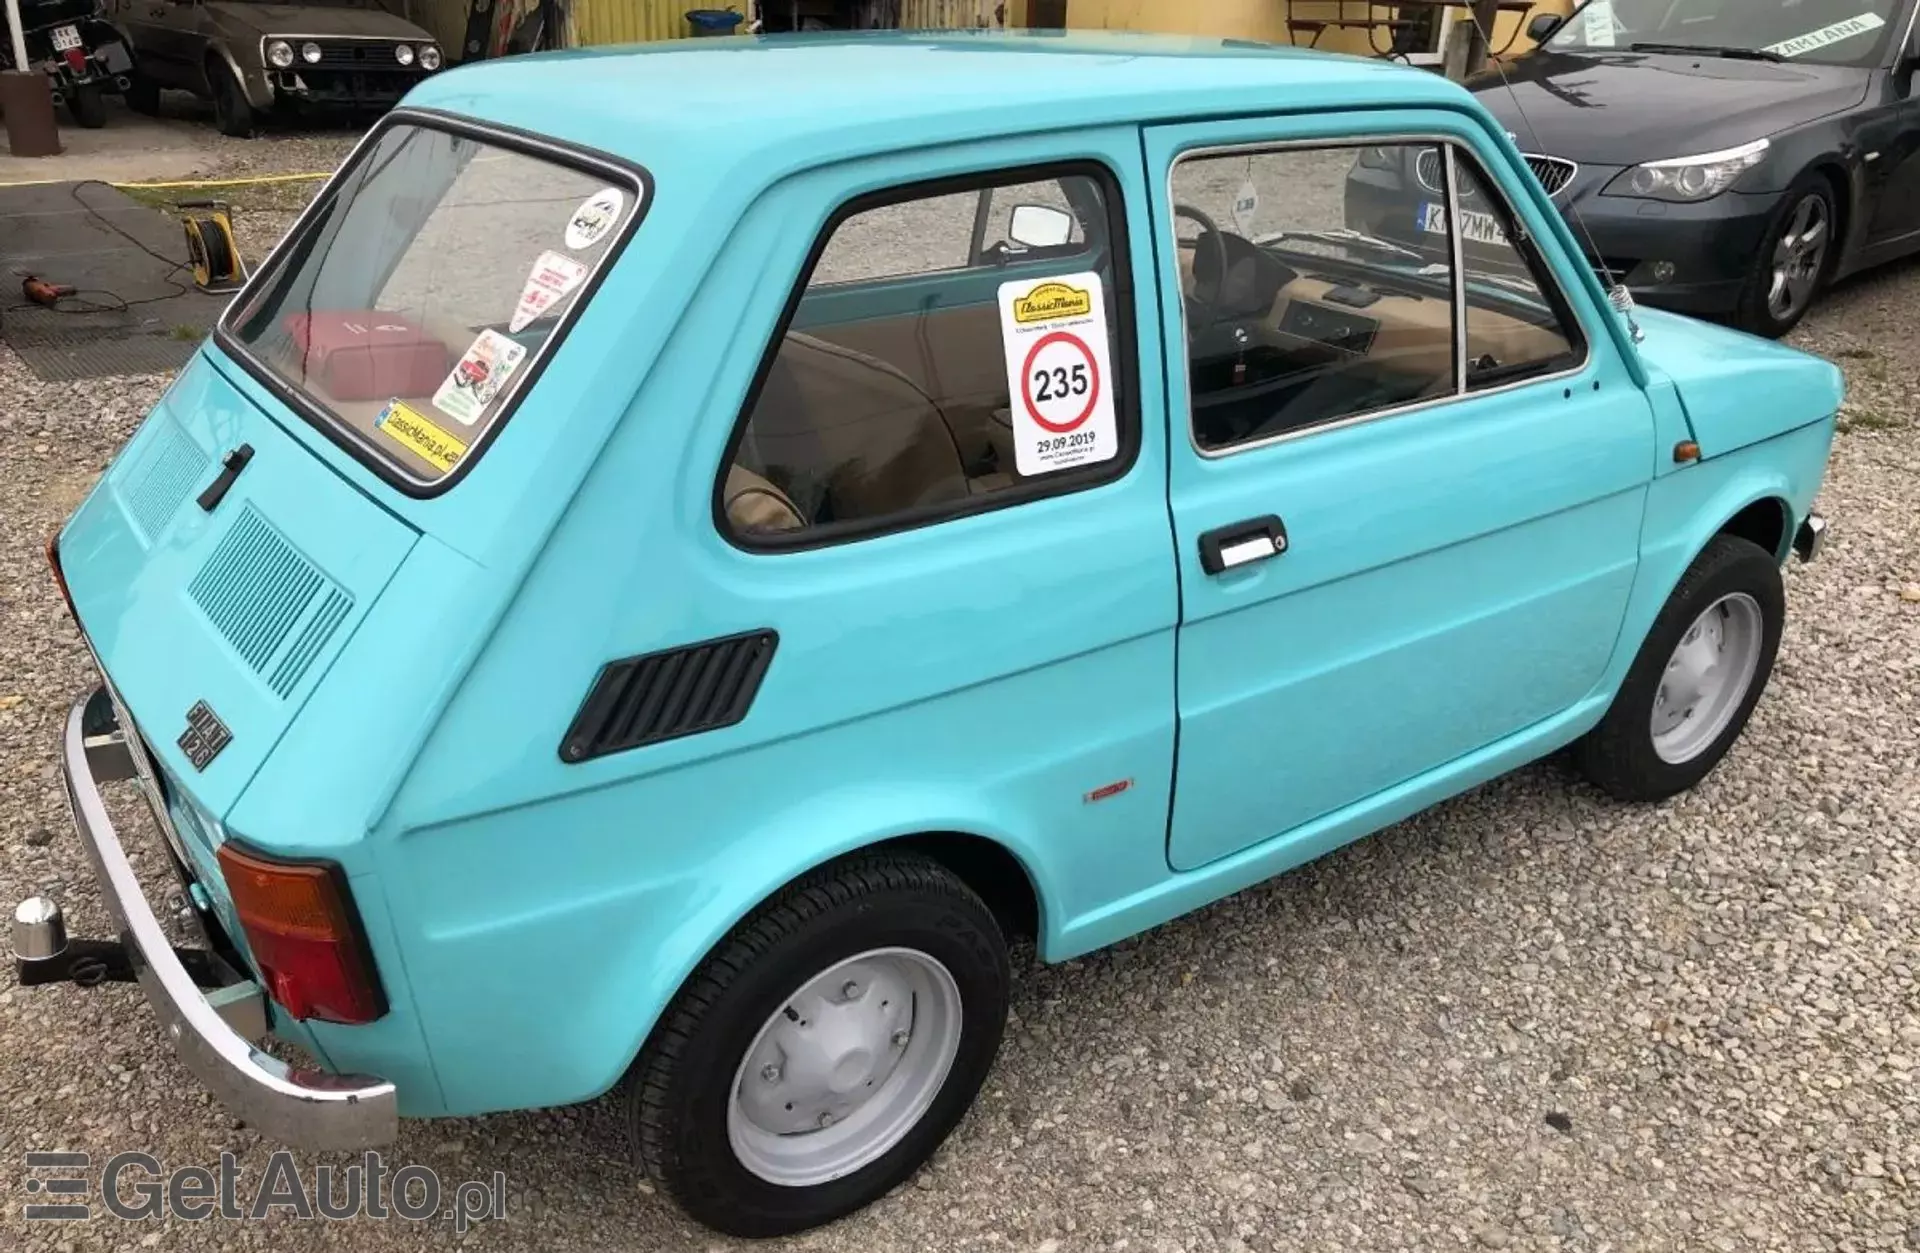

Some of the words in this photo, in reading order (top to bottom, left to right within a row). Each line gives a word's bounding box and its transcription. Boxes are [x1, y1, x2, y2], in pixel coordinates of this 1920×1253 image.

[1021, 297, 1083, 315] ClassicMania
[1034, 363, 1088, 402] 235
[1037, 430, 1096, 453] 29.09.2019
[189, 703, 227, 747] FIAT
[180, 731, 210, 766] 126
